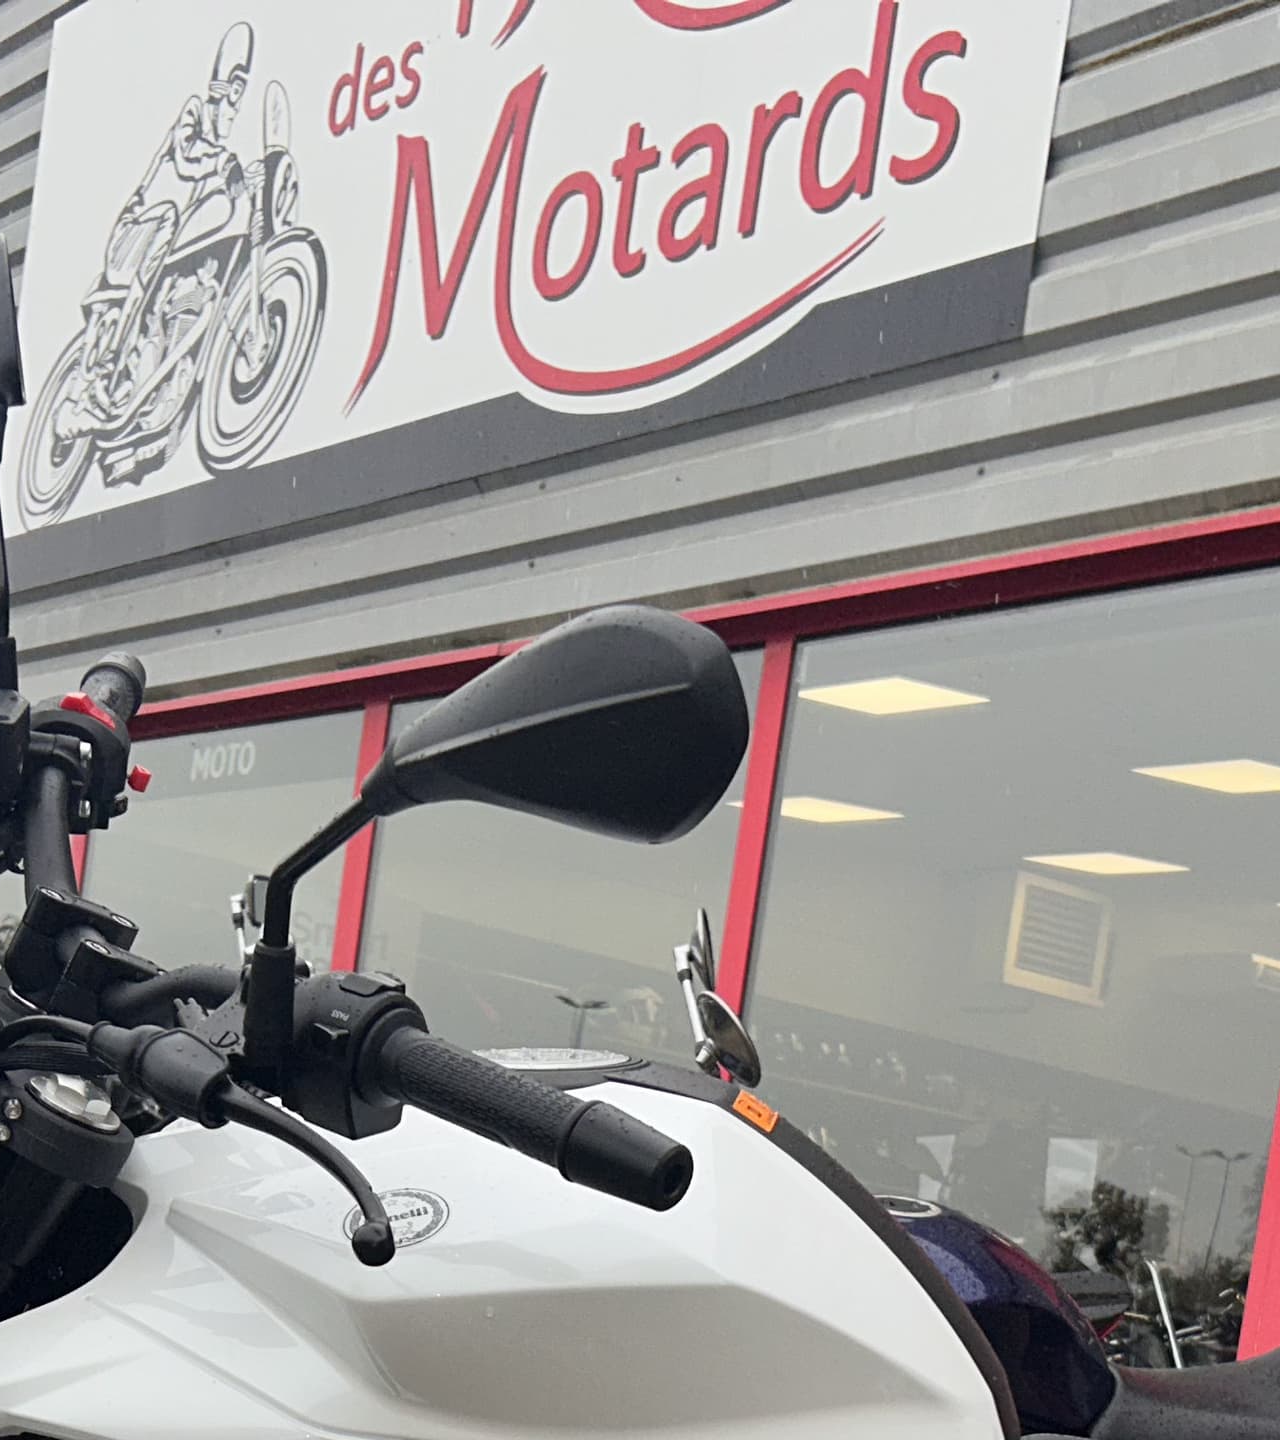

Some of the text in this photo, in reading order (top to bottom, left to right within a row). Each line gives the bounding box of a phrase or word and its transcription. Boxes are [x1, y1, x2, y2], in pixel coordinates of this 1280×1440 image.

[329, 42, 423, 137] des
[342, 0, 968, 416] Motards
[190, 740, 257, 783] MOTO
